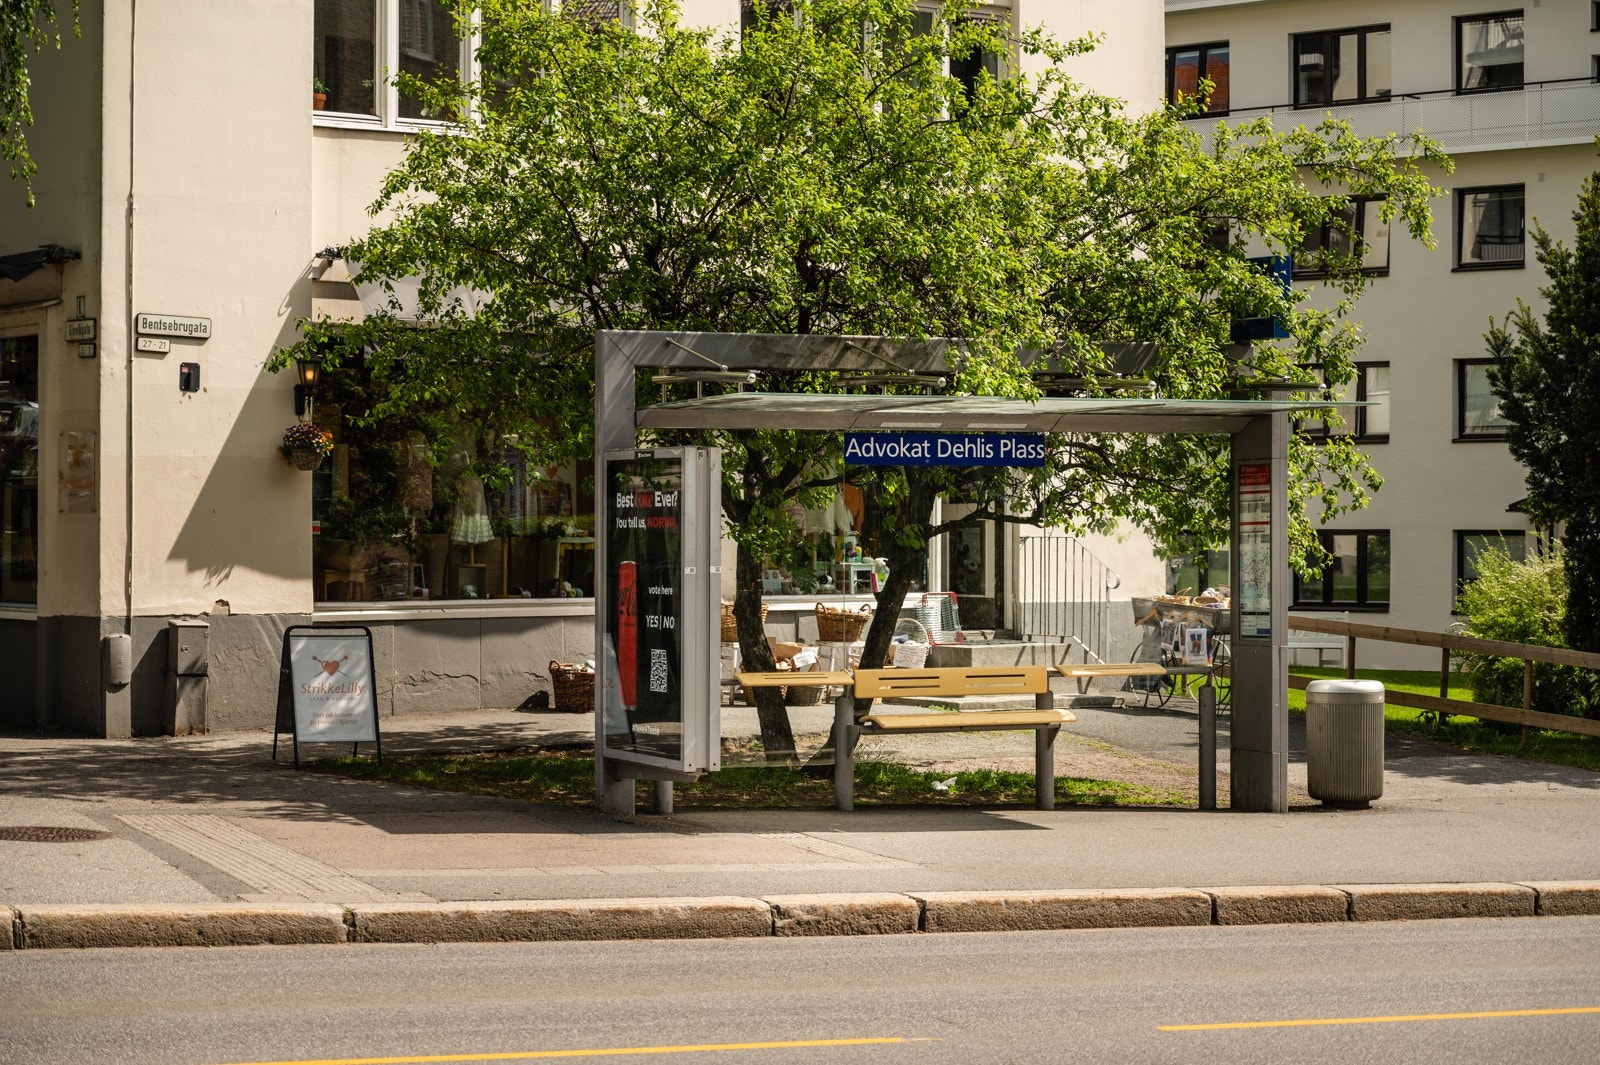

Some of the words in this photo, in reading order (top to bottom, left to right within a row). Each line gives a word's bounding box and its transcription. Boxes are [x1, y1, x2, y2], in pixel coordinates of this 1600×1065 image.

[142, 317, 208, 336] Bentsebrugata
[845, 437, 931, 458] Advokat
[937, 437, 994, 459] Dehlis
[1000, 438, 1045, 459] Plass
[616, 491, 634, 508] Best
[654, 490, 678, 507] Ever?
[616, 517, 628, 529] You
[628, 516, 638, 528] tell
[647, 516, 678, 529] NORWA
[648, 586, 661, 595] vote
[661, 585, 674, 595] here
[645, 615, 659, 628] YES
[663, 616, 675, 629] NO
[301, 682, 364, 696] StrikkeLilly
